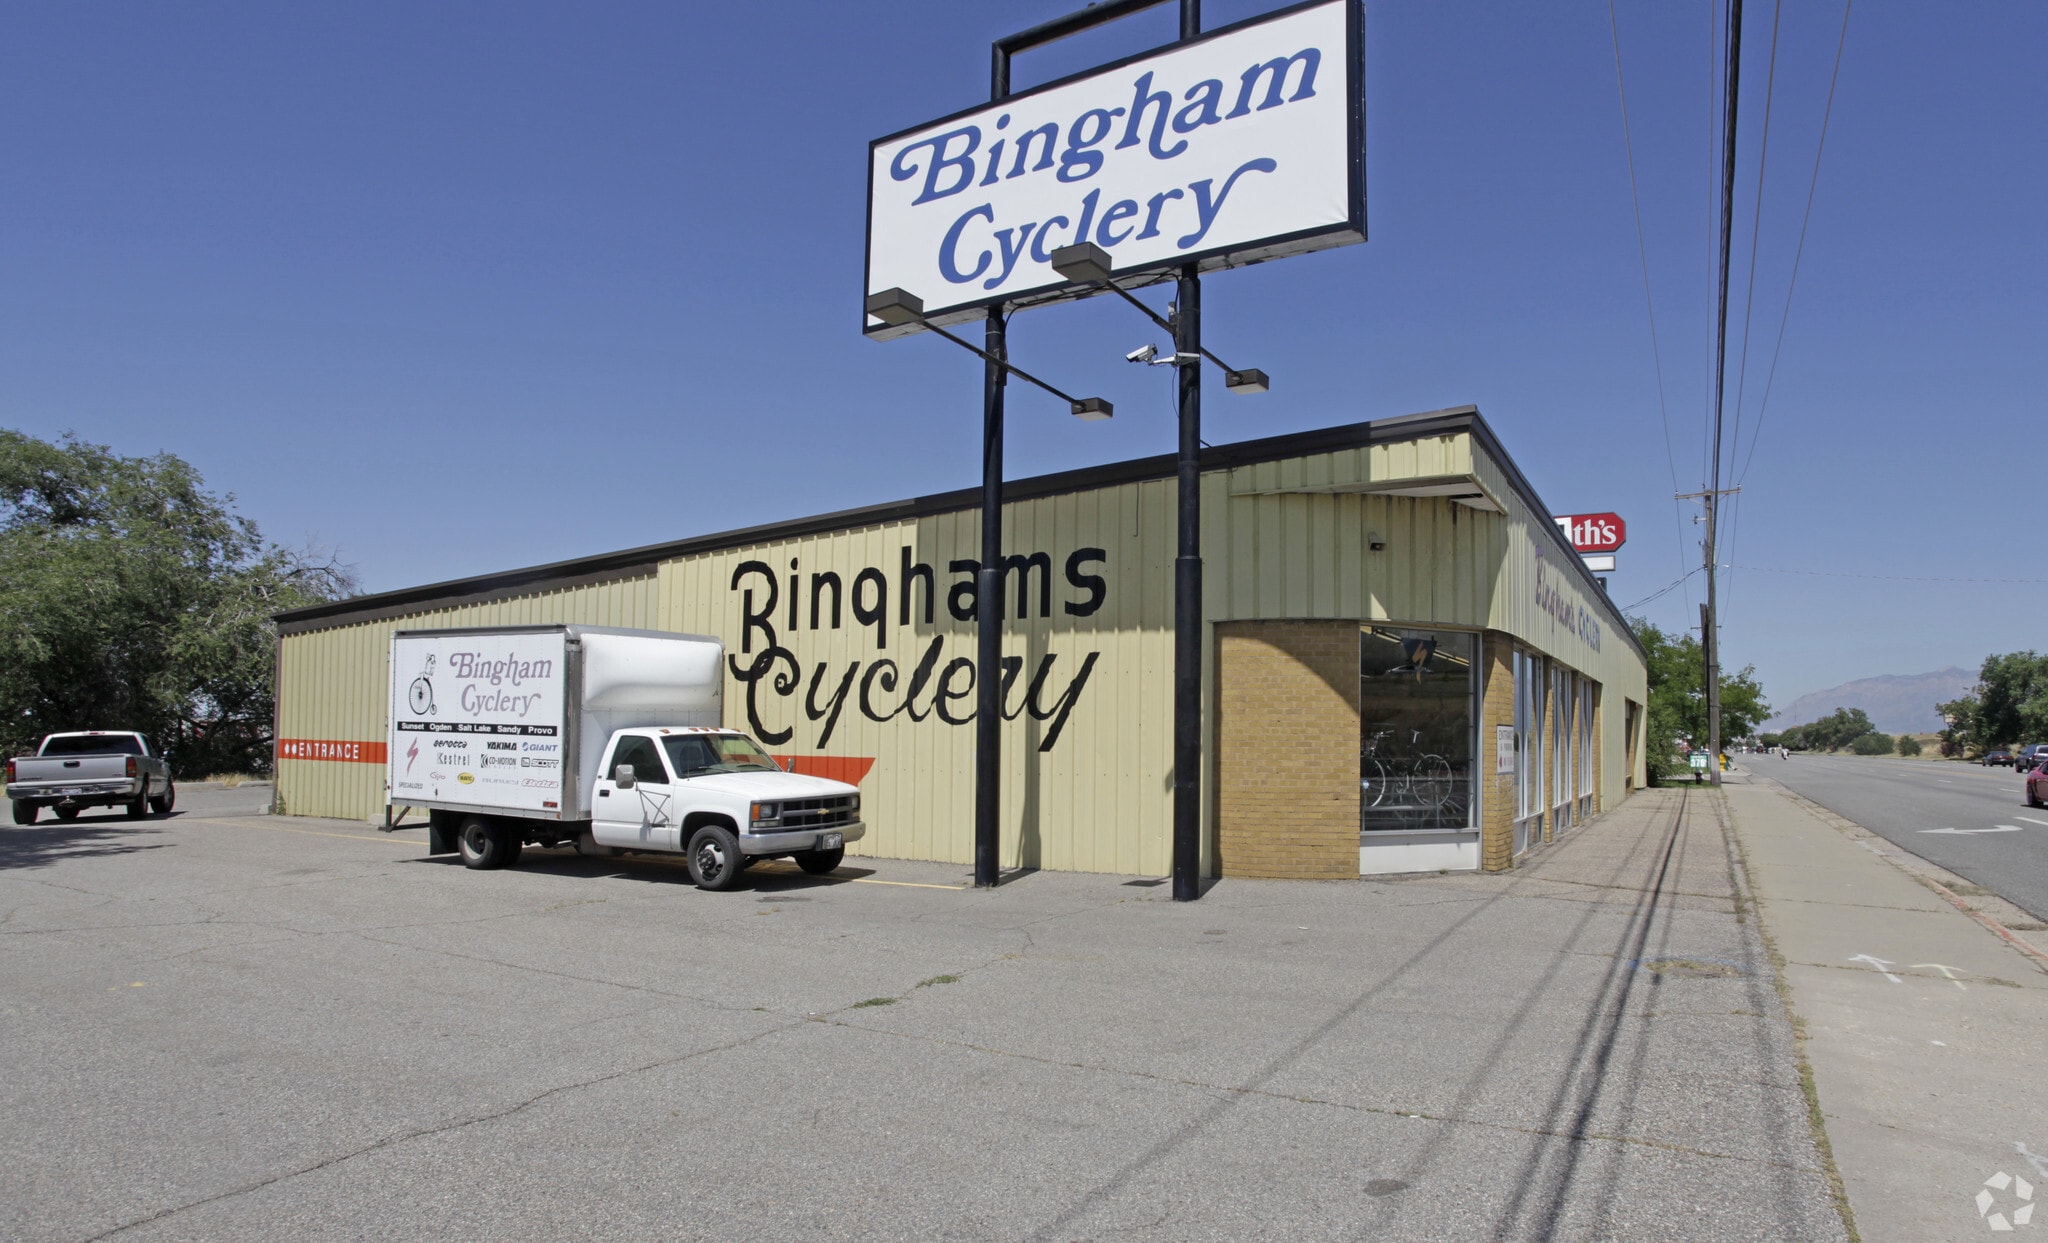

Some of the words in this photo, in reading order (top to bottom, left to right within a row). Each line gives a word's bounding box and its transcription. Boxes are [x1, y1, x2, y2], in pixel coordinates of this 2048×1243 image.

[890, 47, 1321, 206] Bingham
[938, 157, 1277, 290] Cyclery
[449, 652, 552, 686] Bingham
[461, 683, 542, 718] Cyclery
[401, 722, 425, 730] Sunset
[429, 723, 453, 732] Ogden
[458, 724, 473, 732] Salt
[473, 725, 492, 733] Lake
[497, 725, 522, 735] Sandy
[528, 726, 553, 735] Provo
[298, 742, 359, 760] ENTRANCE
[486, 741, 517, 751] YAKIMA
[529, 743, 558, 752] GIANT
[437, 752, 470, 766] Kestrel
[530, 758, 560, 769] SCOTT
[521, 778, 559, 789] Electra
